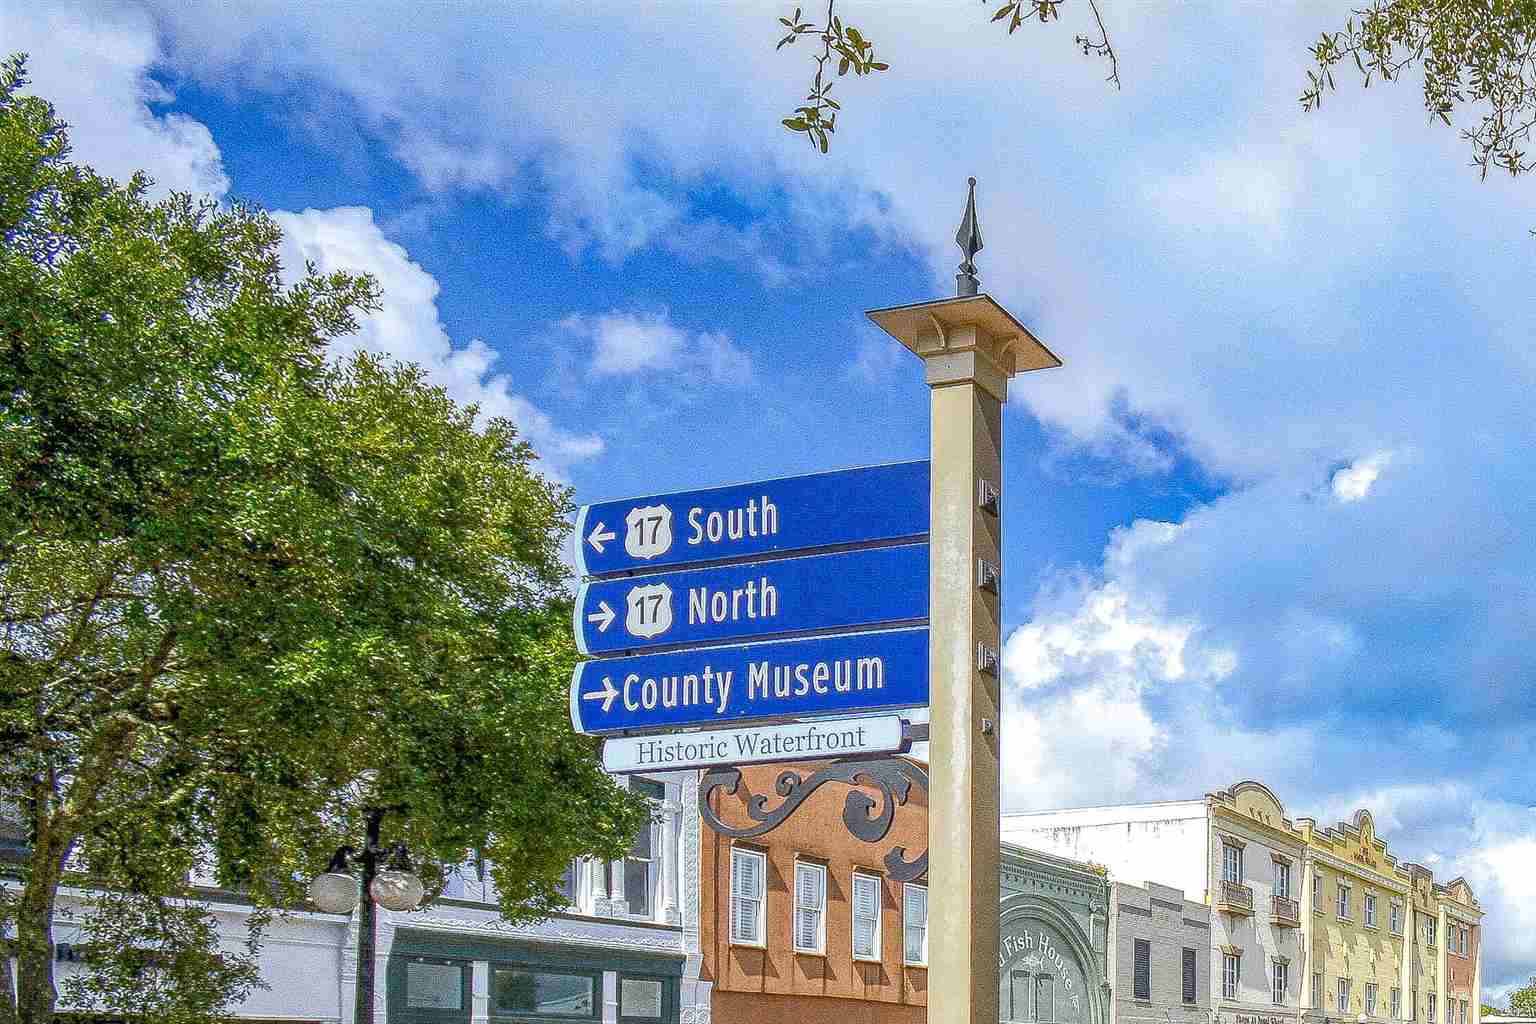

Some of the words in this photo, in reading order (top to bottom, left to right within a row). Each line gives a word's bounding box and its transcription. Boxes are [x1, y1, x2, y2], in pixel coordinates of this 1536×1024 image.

[634, 516, 663, 545] 17
[687, 495, 777, 545] South
[634, 593, 664, 625] 17
[688, 576, 777, 625] North
[623, 665, 733, 713] County
[748, 656, 884, 700] Museum
[637, 738, 728, 765] Historic
[735, 726, 866, 756] Waterfront
[1002, 929, 1033, 956] Fish
[1038, 932, 1072, 991] House
